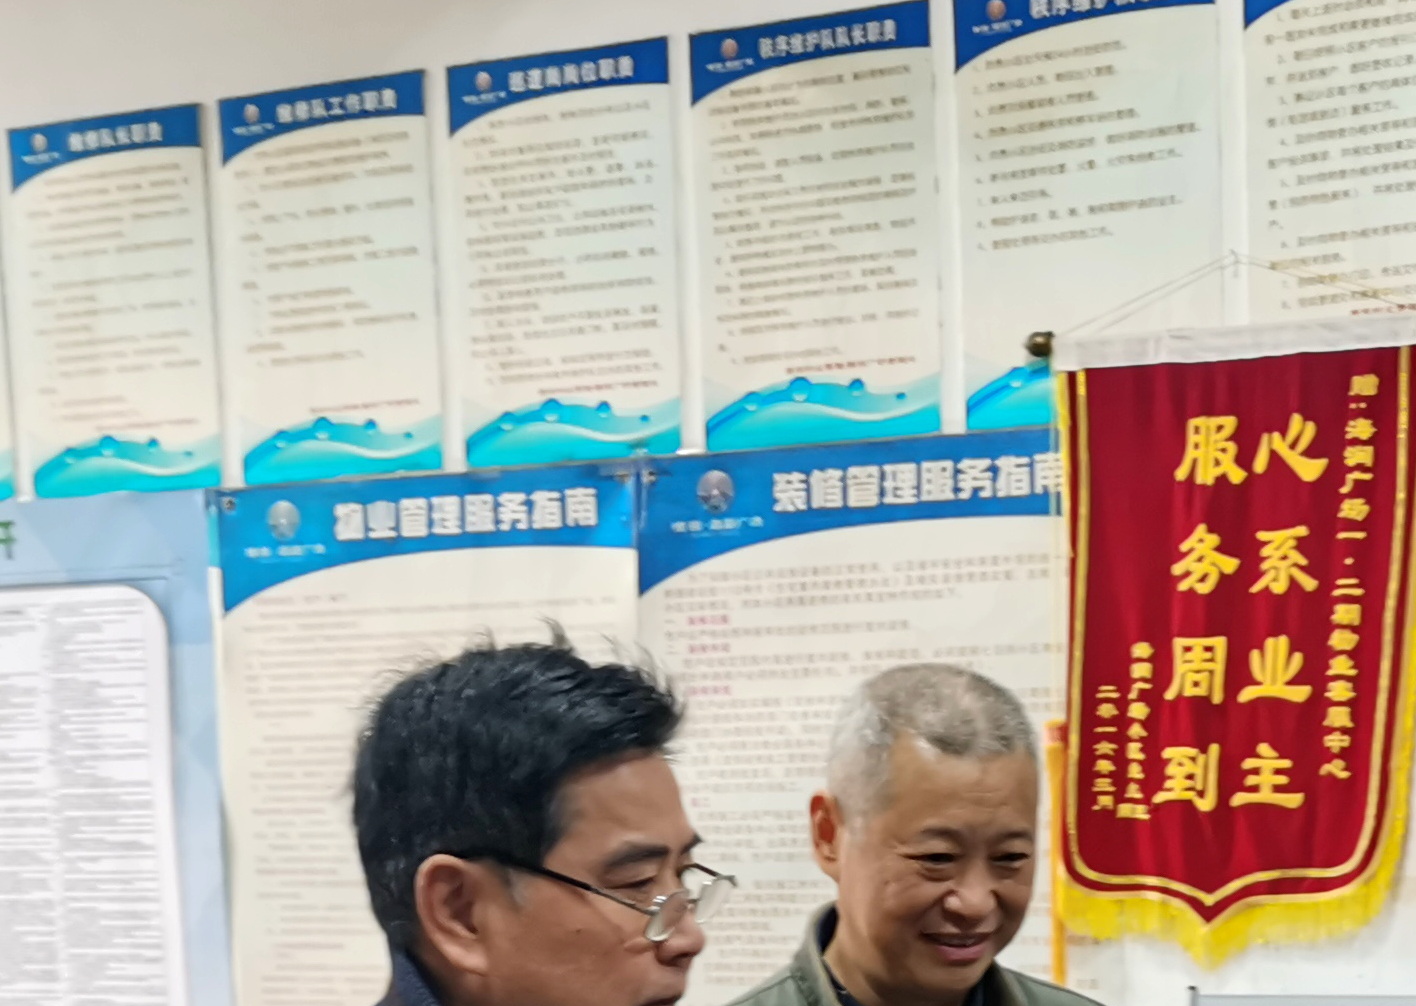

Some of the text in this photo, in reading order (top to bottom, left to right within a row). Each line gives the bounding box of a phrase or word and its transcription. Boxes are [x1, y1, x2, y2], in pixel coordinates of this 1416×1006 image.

[333, 488, 598, 541] 物业管理服务指南
[772, 451, 1064, 512] 装修管理服务指南
[1152, 415, 1249, 812] 服务周到
[1230, 412, 1330, 809] 心系业主
